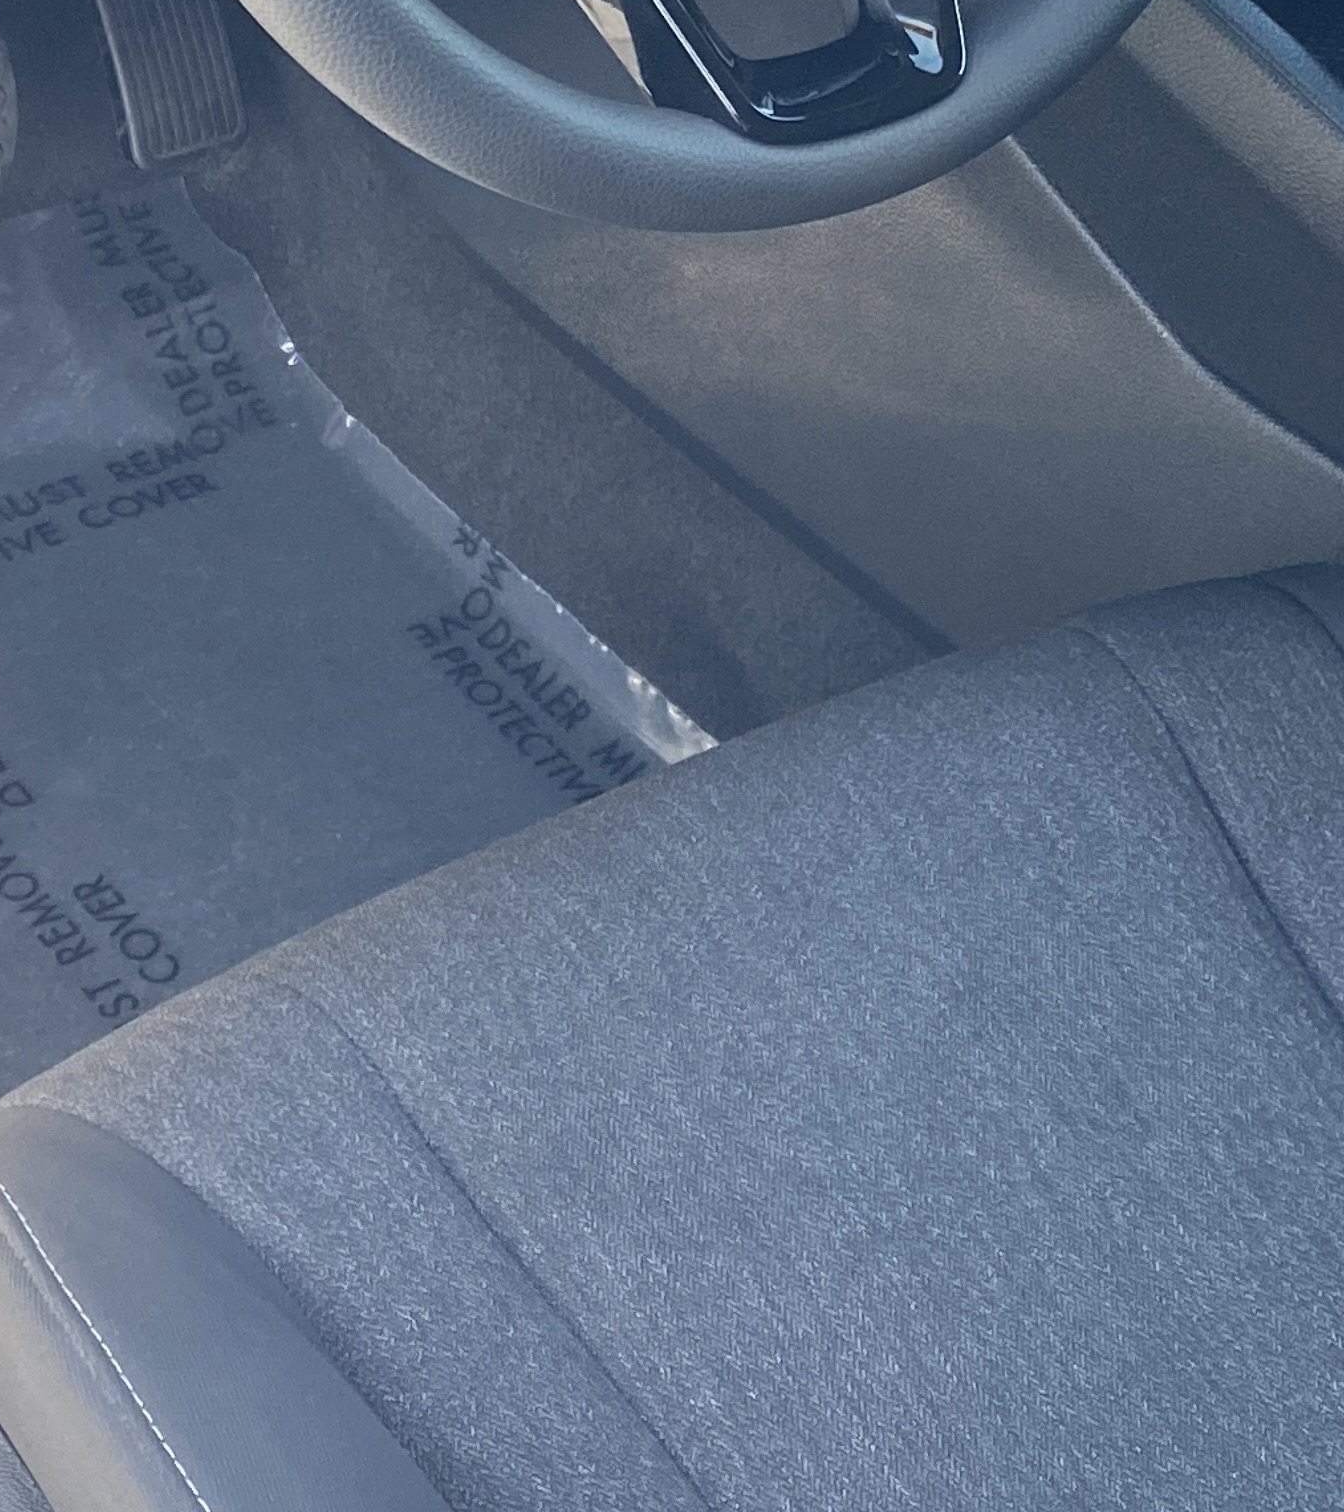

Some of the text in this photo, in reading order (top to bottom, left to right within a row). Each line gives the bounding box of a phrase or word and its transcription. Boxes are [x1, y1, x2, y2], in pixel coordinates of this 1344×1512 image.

[121, 282, 213, 416] DEALER
[78, 471, 220, 529] COVER
[431, 645, 605, 804] PROTECTIV
[476, 617, 591, 732] DEALER
[73, 874, 180, 983] COVER
